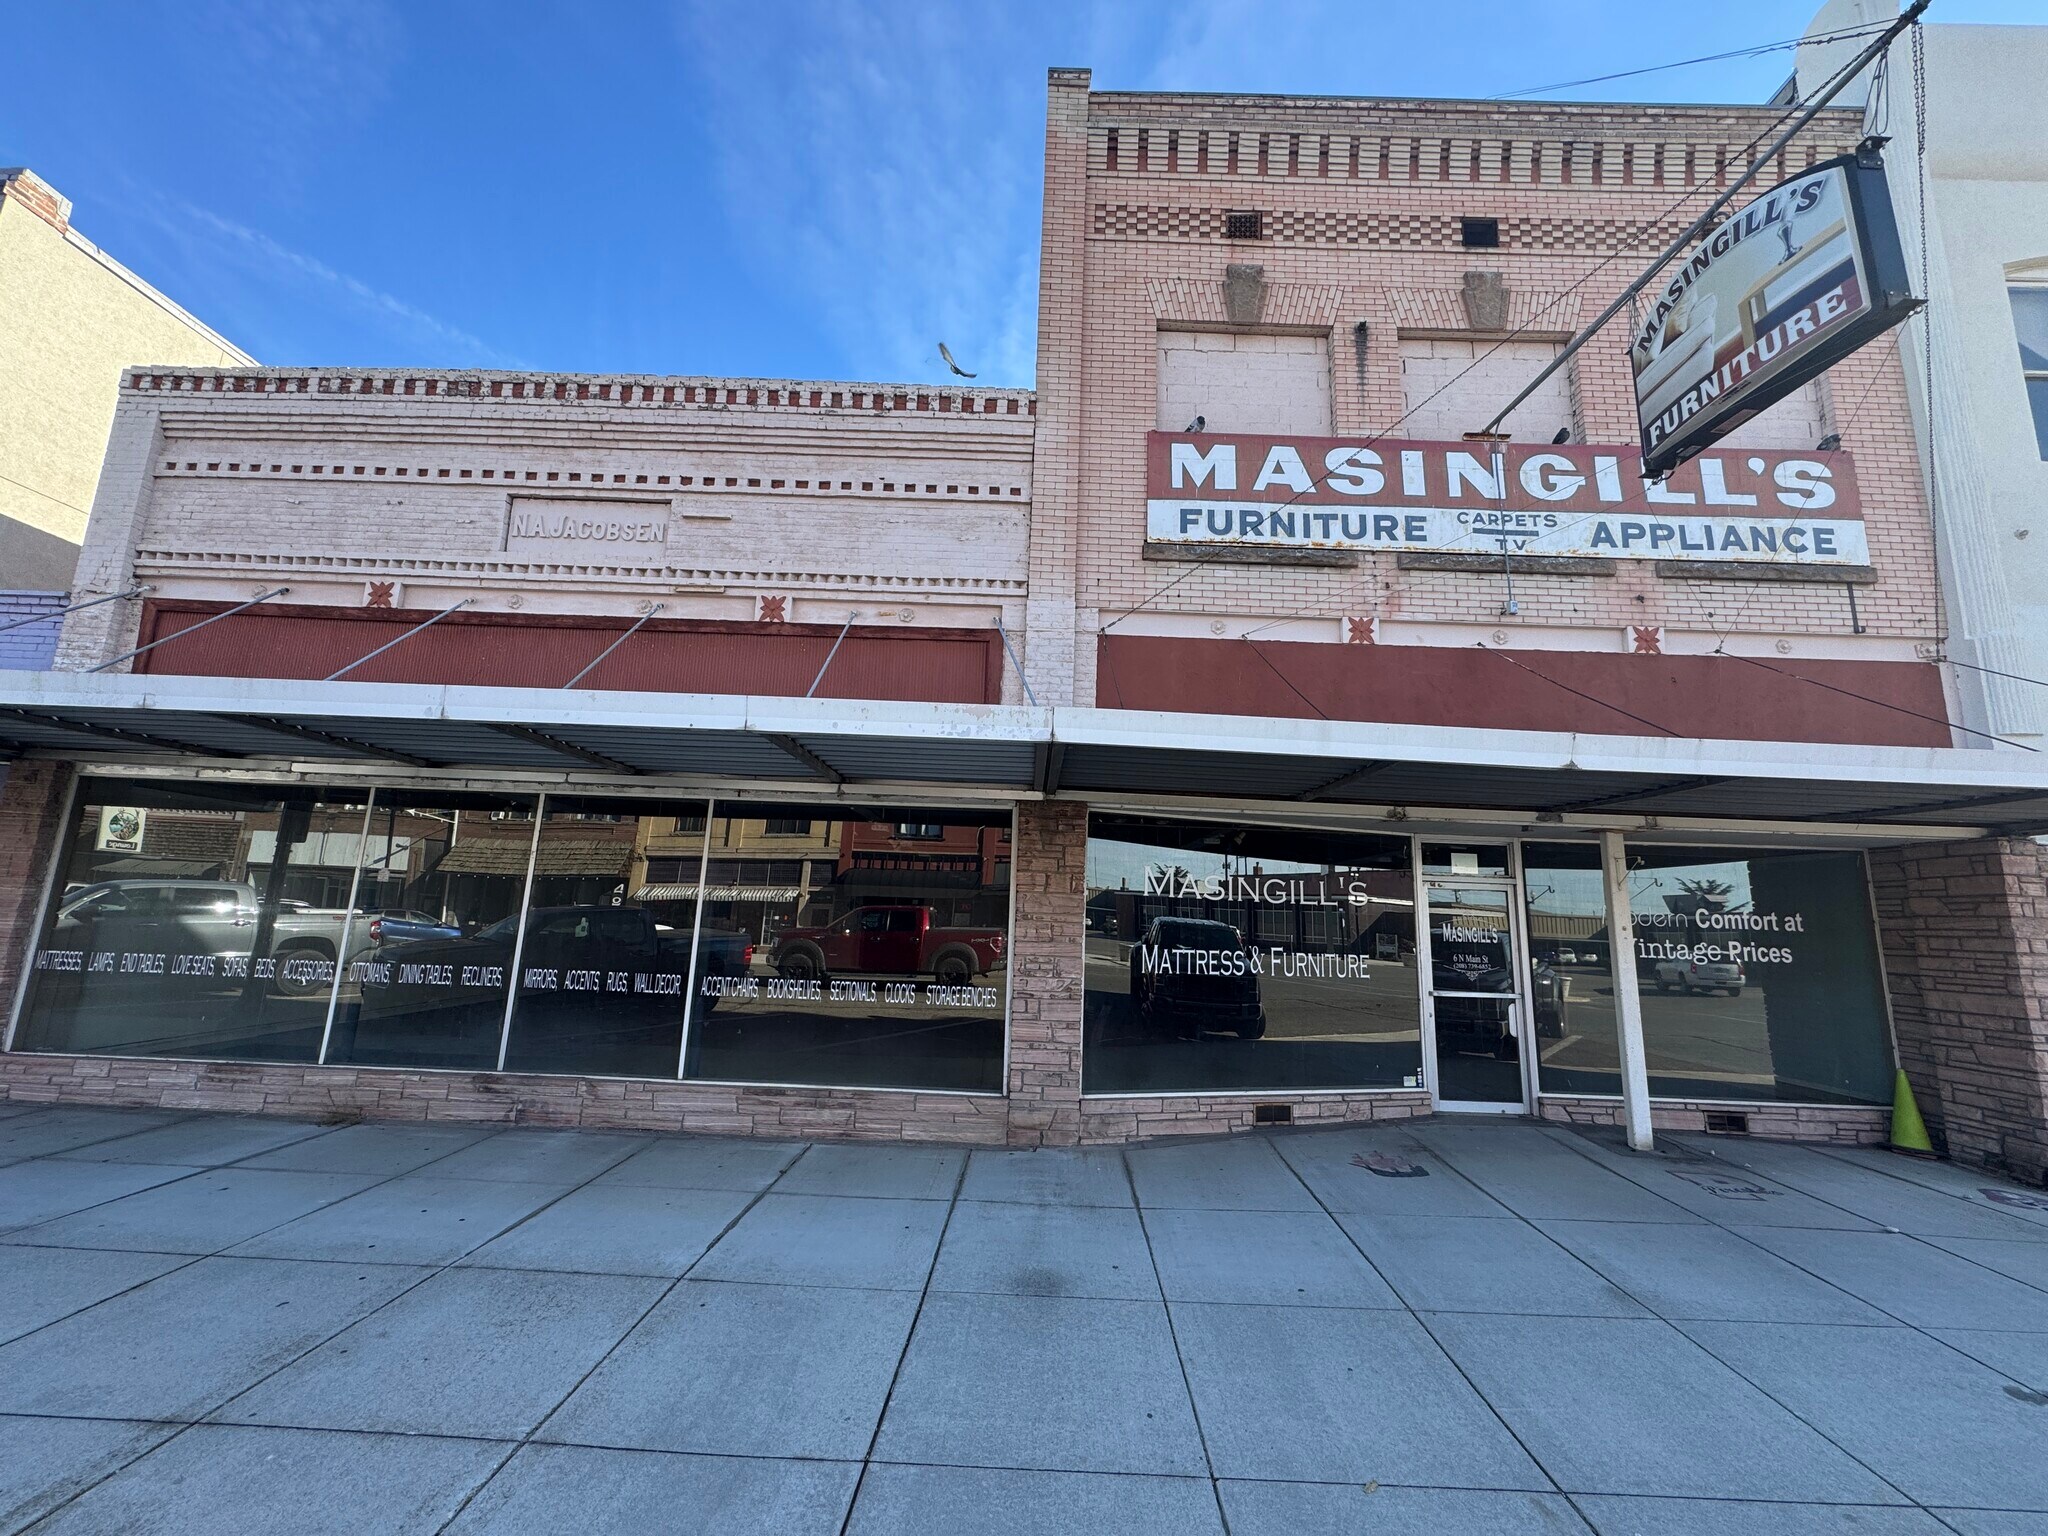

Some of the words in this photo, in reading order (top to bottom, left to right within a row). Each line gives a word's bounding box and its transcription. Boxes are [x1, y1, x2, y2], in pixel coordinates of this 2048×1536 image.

[1637, 178, 1826, 355] MASINGILL'S
[1650, 284, 1847, 449] FURNITURE
[1171, 443, 1836, 509] MASINGILL'S
[1180, 508, 1428, 542] FURNITURE
[1590, 522, 1838, 556] APPLIANCE
[1457, 512, 1558, 528] CARPETS
[1143, 865, 1369, 907] MASINGILL'S
[1442, 923, 1498, 944] MASINGILL'S
[1695, 908, 1779, 931] Comfort
[1784, 913, 1804, 932] at
[35, 950, 83, 973] MATTRESSES,
[88, 952, 115, 974] LAMPS,
[222, 958, 248, 979] SOFAS,
[254, 958, 276, 980] BEDS,
[1141, 944, 1246, 976] MATTRESS
[1250, 946, 1265, 974] &
[1271, 947, 1370, 979] FURNITURE
[1453, 953, 1458, 963] 6
[1458, 953, 1464, 963] N
[1465, 954, 1481, 963] Main
[1481, 954, 1489, 964] St
[1632, 938, 1721, 965] intage
[1728, 941, 1793, 963] Prices
[461, 966, 503, 988] RECLINERS,
[523, 968, 558, 991] MIRRORS,
[563, 970, 600, 993] ACCENTS,
[606, 972, 628, 995] RUGS,
[700, 976, 732, 997] ACCENT
[926, 985, 961, 1006] STORAGE
[961, 987, 997, 1008] BENCHES
